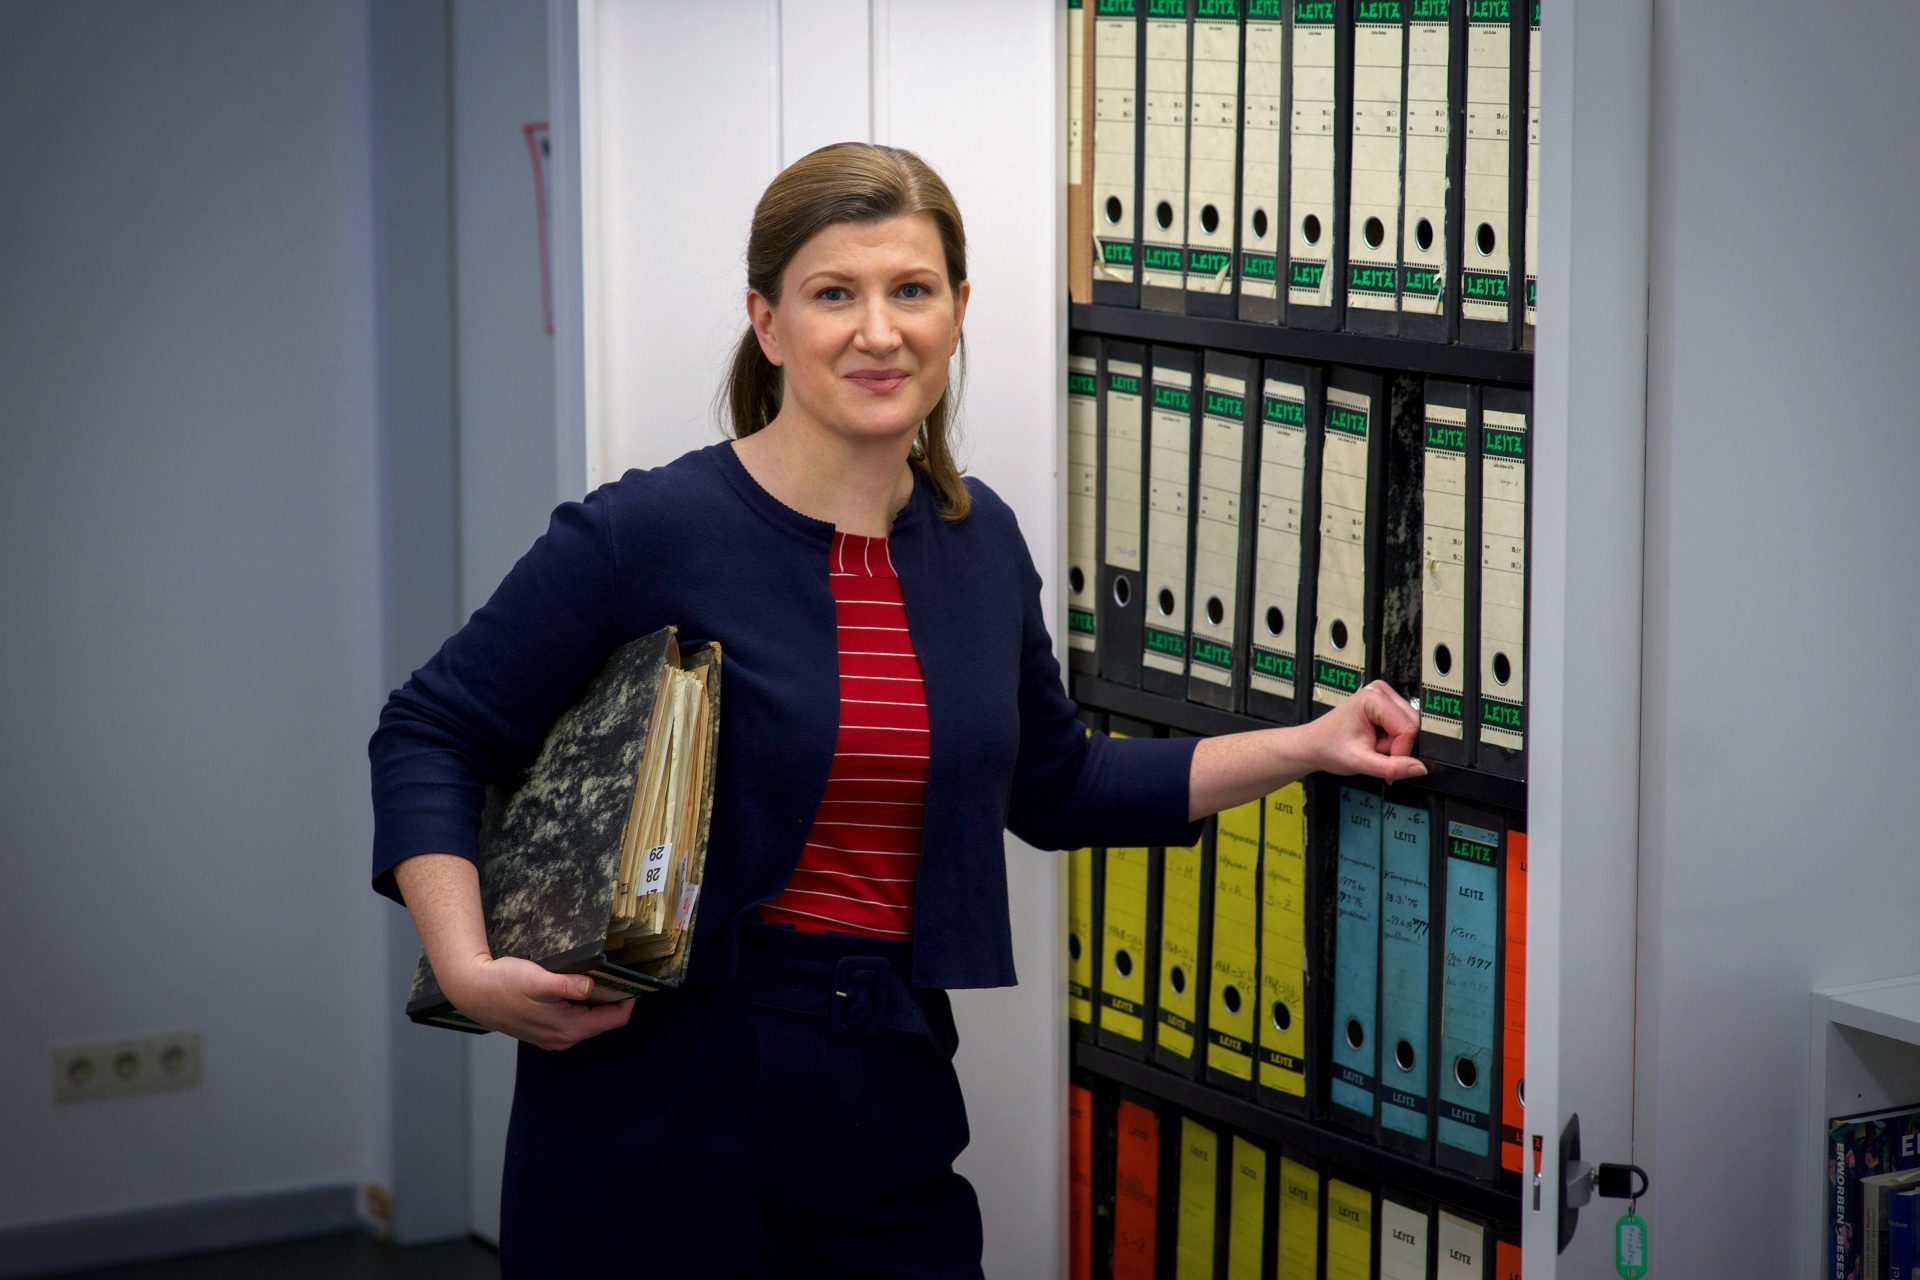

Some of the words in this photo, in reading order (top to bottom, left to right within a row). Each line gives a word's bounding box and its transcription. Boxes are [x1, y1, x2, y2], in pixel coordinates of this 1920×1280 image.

[1099, 0, 1135, 14] LEITZ
[1149, 0, 1185, 17] LEITZ
[1198, 0, 1236, 17] LEITZ
[1248, 0, 1281, 17] LEITZ
[1296, 2, 1335, 24] LEITZ
[1359, 0, 1401, 20] LEITZ
[1413, 0, 1449, 18] LEITZ
[1473, 0, 1510, 19] LEITZ
[1144, 248, 1182, 268] LEITZ
[1244, 256, 1277, 276] LEITZ
[1293, 266, 1324, 285] LEIT
[1352, 268, 1395, 288] LEITZ
[1467, 277, 1509, 297] LEITZ
[1111, 375, 1138, 392] LEITZ
[1155, 387, 1190, 410] LEITZ
[1208, 394, 1243, 416] LEITZ
[1266, 400, 1304, 423] LEITZ
[1330, 410, 1367, 433] LEITZ
[1428, 427, 1465, 448] LEITZ
[1486, 432, 1523, 454] LEITZ
[1148, 631, 1183, 654] LEITZ
[1194, 641, 1231, 665] LEITZ
[1256, 653, 1294, 676] LEITZ
[1319, 666, 1357, 689] LEITZ
[1424, 692, 1462, 715] LEITZ
[1485, 704, 1521, 726] LEITZ
[1274, 801, 1294, 815] LEITZ
[1351, 815, 1372, 829] LEITZ
[1394, 830, 1417, 844] LEITZ
[649, 846, 665, 861] 29
[1453, 840, 1490, 862] LEITZ
[646, 867, 661, 883] 28
[1459, 886, 1484, 901] LEITZ
[1466, 955, 1493, 970] 1977
[1112, 997, 1134, 1013] LEITZ
[1168, 1014, 1187, 1031] LEITZ
[1219, 1035, 1243, 1052] LEITZ
[1270, 1052, 1294, 1070] LEITZ
[1342, 1068, 1364, 1086] LEITZ
[1392, 1091, 1416, 1108] LEITZ
[1450, 1106, 1477, 1124] LEITZ
[1289, 1184, 1309, 1201] LEITZ
[1836, 1142, 1846, 1225] ERWORBEN
[1338, 1205, 1360, 1222] LEITZ
[1393, 1229, 1416, 1246] LEITZ
[1449, 1248, 1472, 1266] LEITZ
